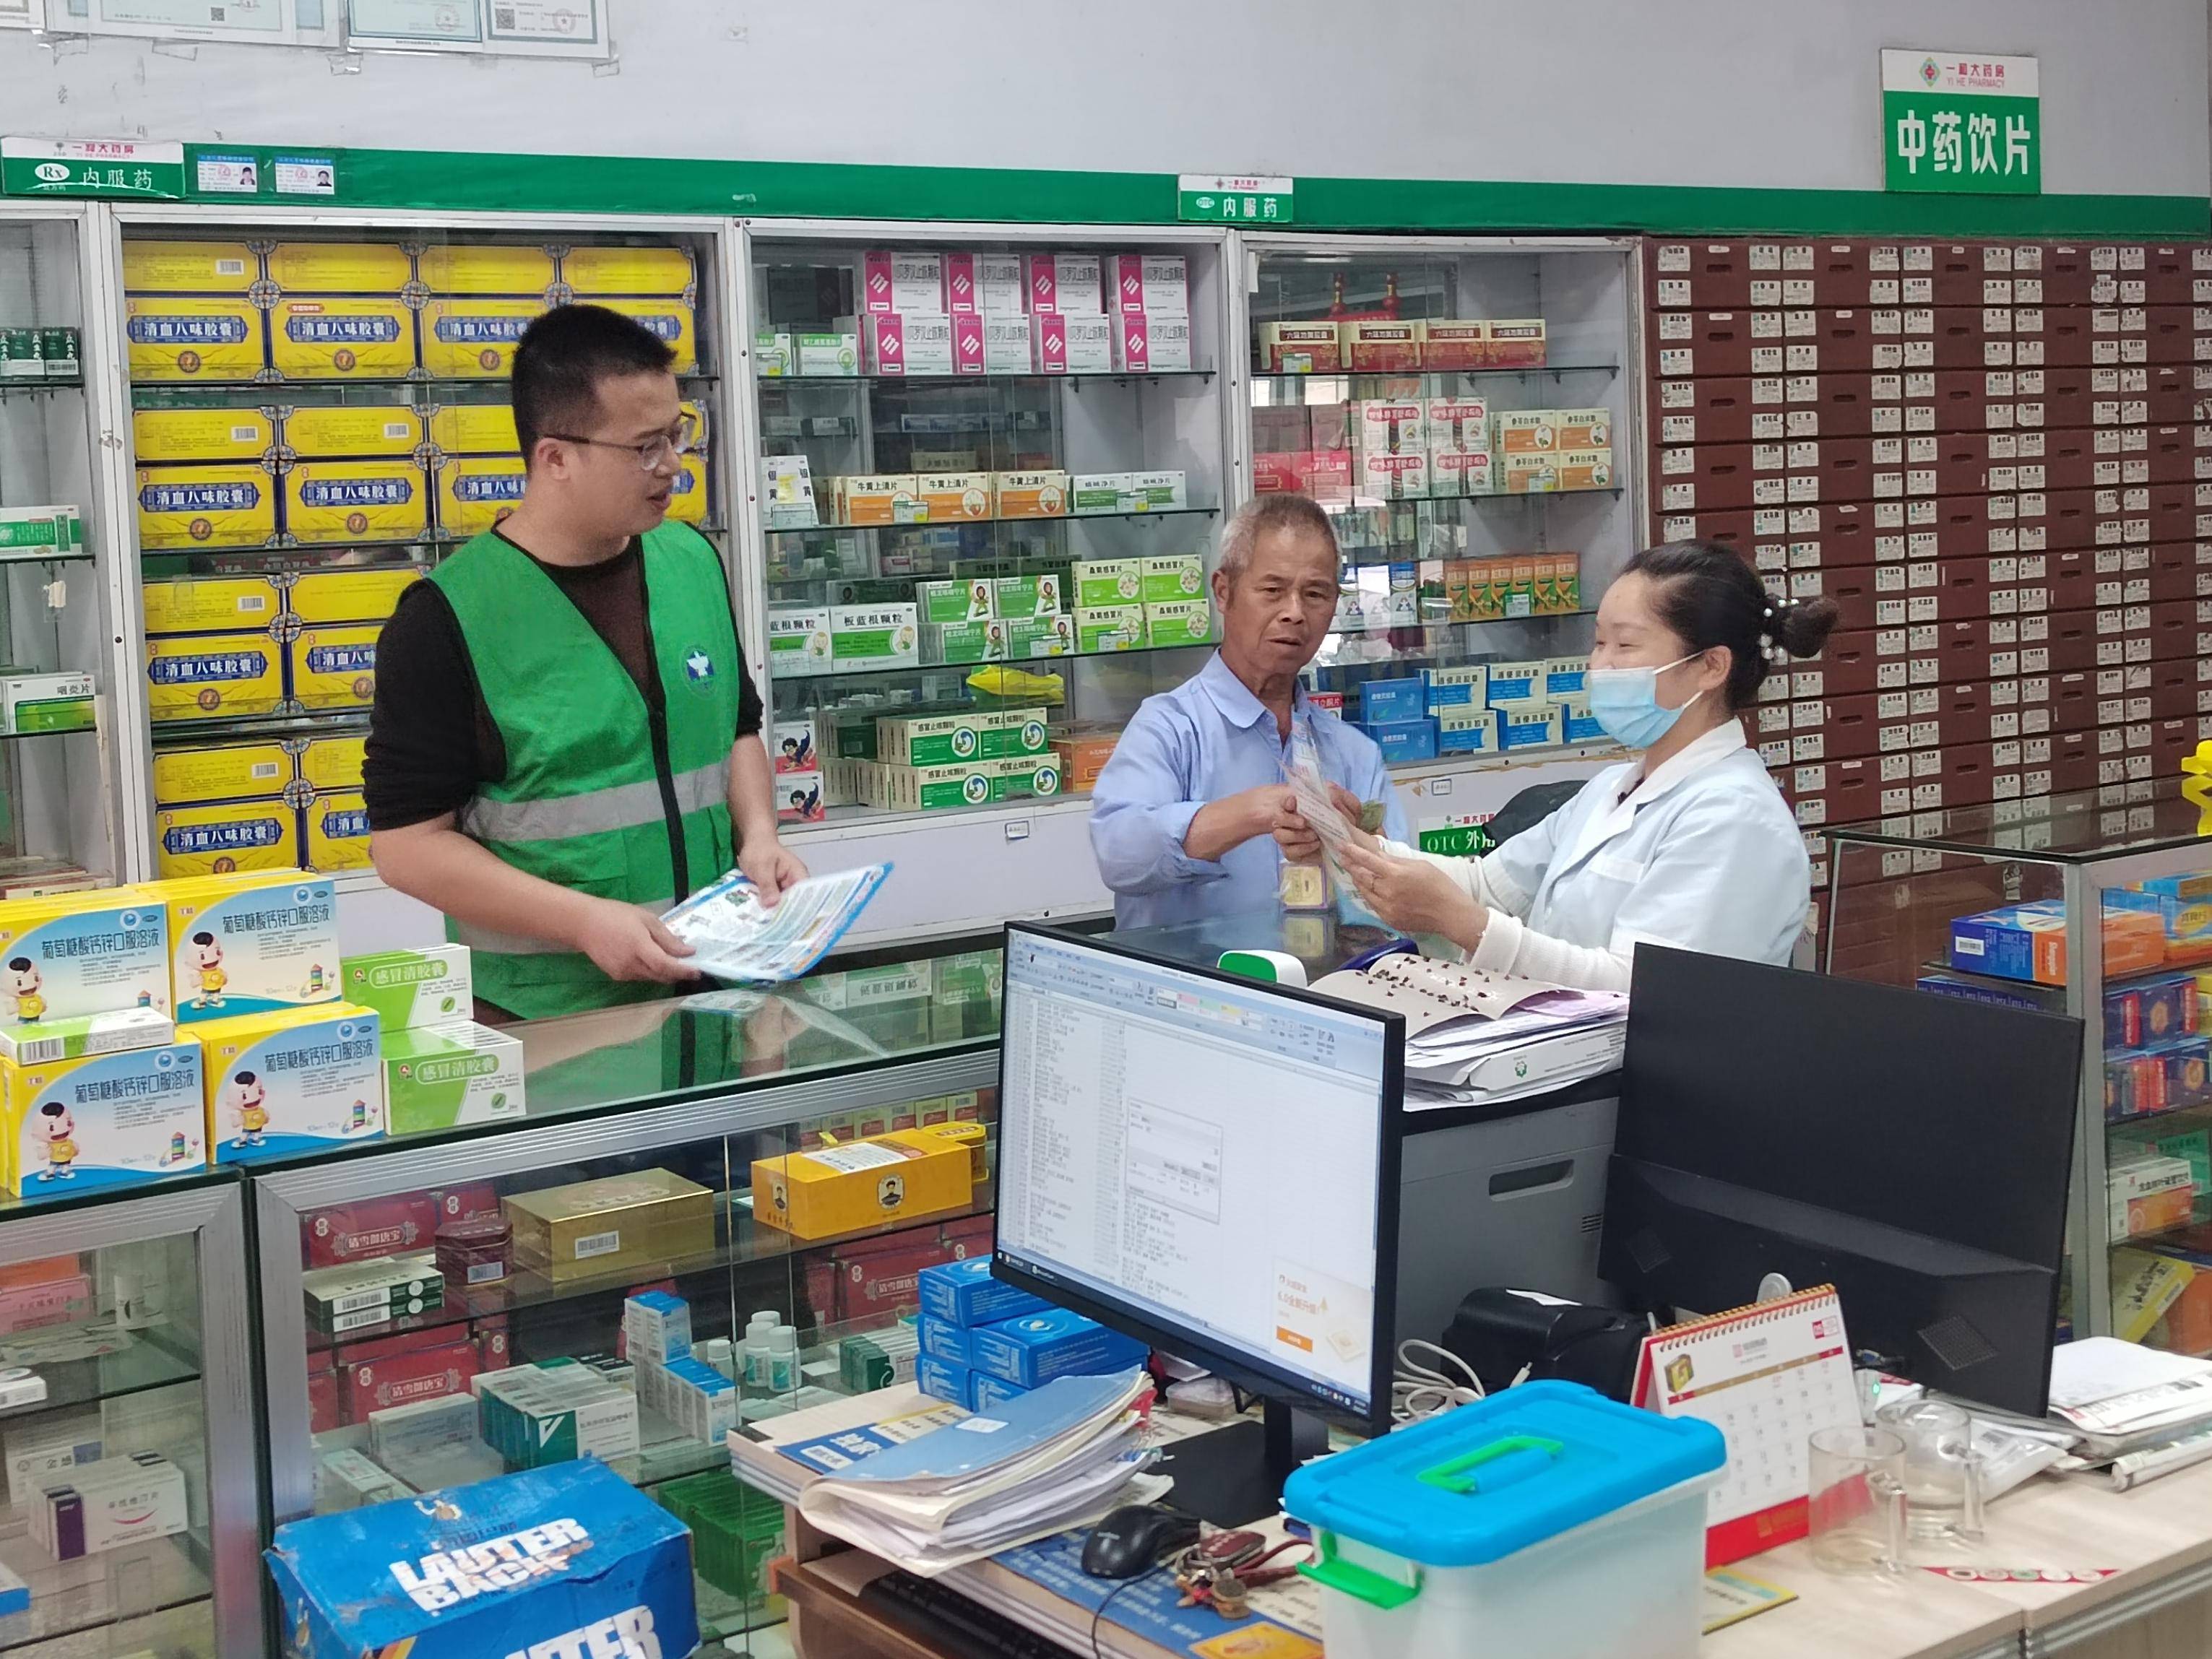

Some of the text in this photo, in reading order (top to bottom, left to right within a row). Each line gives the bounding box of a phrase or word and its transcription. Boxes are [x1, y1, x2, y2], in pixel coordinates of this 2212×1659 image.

[1897, 109, 2031, 176] 中药饮片
[83, 167, 152, 189] 内服药
[1223, 196, 1277, 217] 内服药
[144, 322, 233, 337] 清血八味胶囊
[301, 322, 386, 337] 清血八味胶囊
[156, 488, 244, 505] 清血八味胶囊
[316, 484, 397, 500] 清血八味胶囊
[844, 613, 903, 626] 板蓝根颗粒
[165, 658, 252, 677] 清血八味胶囊
[57, 683, 90, 696] 咽炎片
[181, 827, 268, 846] 清血八味胶囊
[1427, 833, 1462, 852] OTC
[222, 904, 330, 935] 葡萄糖酸钙锌口服溶液
[42, 927, 160, 960] 葡萄糖酸钙锌口服溶液
[375, 963, 445, 984] 感冒清胶囊
[264, 1039, 373, 1073] 葡萄糖酸钙锌口服溶液
[422, 1057, 496, 1080] 感冒清胶囊
[75, 1068, 195, 1104] 葡萄糖酸钙锌口服溶液
[389, 1518, 589, 1592] LAUTER
